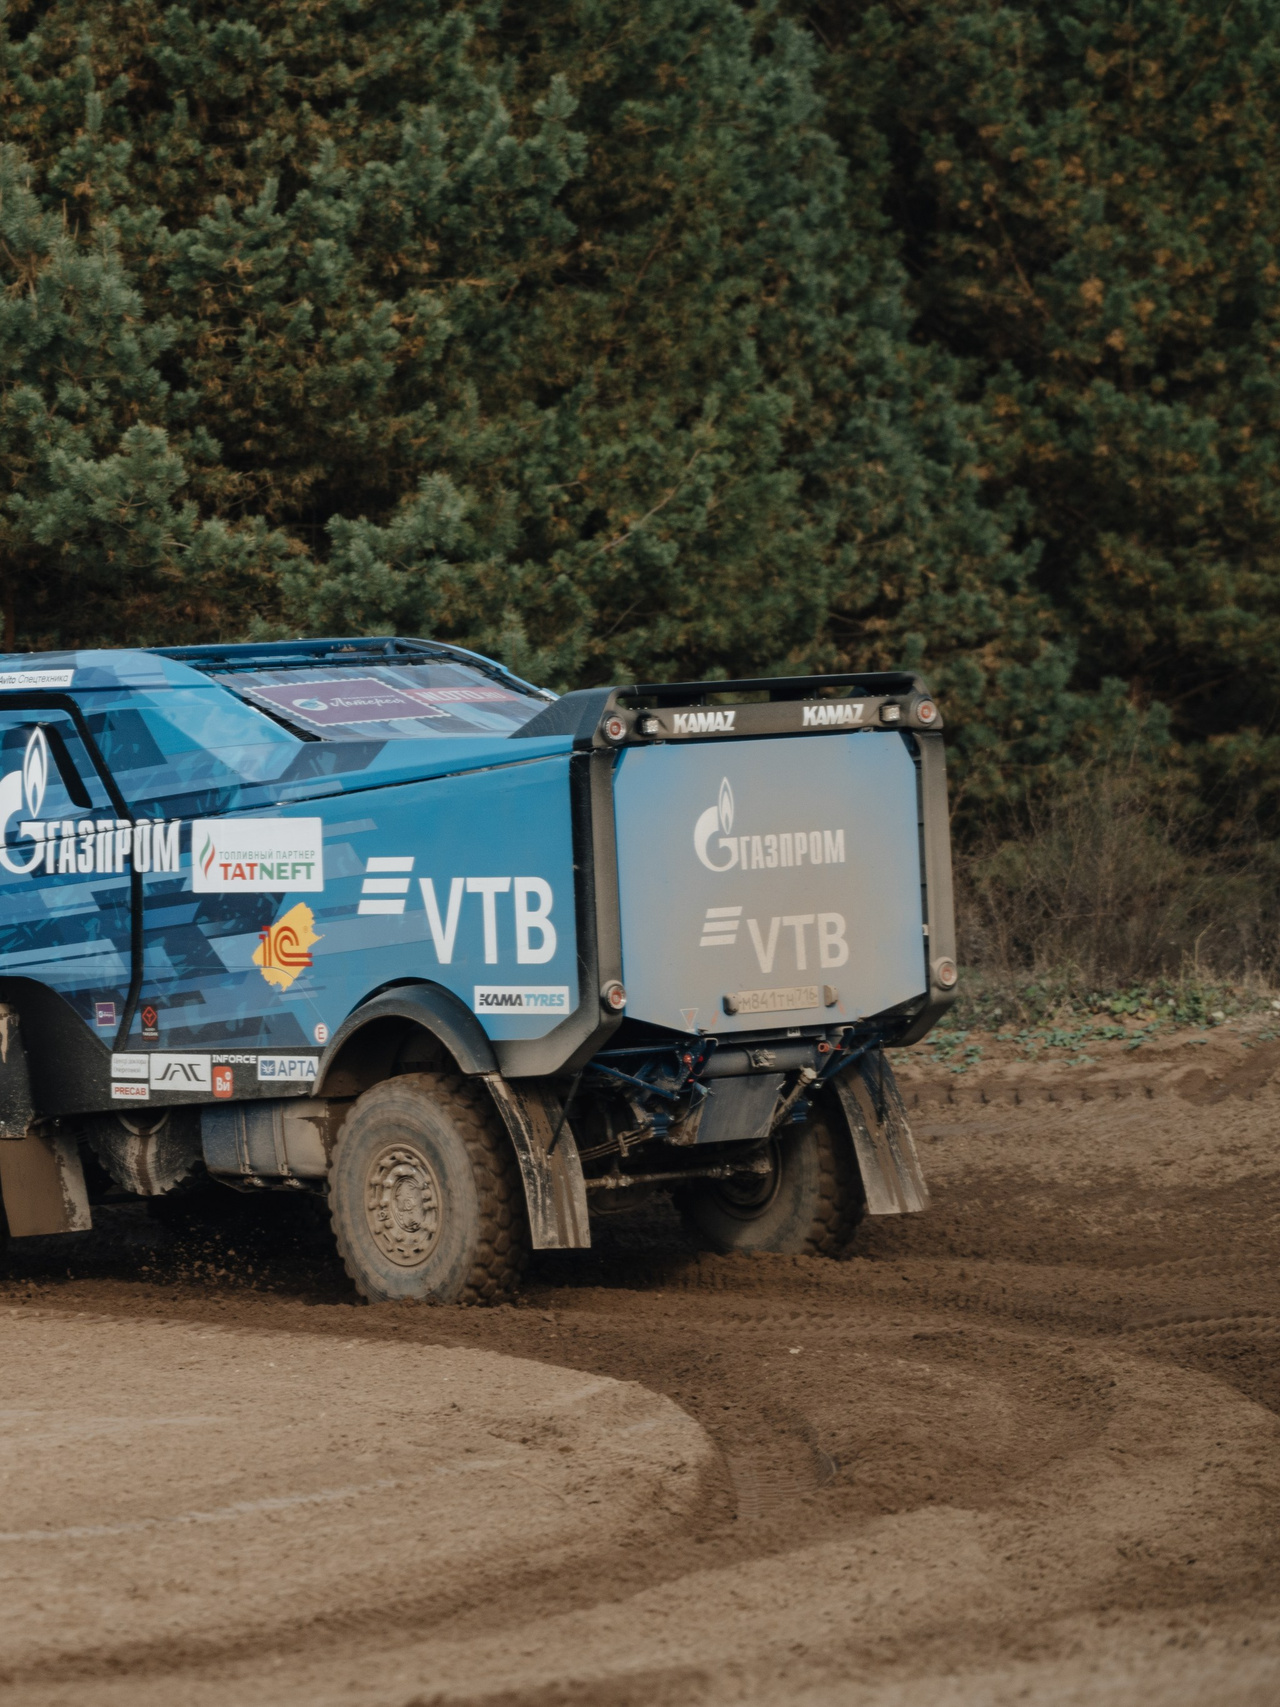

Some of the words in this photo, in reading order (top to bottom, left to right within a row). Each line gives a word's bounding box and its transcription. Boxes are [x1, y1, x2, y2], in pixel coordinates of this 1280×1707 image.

[18, 674, 68, 685] Спецтехника
[673, 711, 736, 733] KAMAZ
[802, 704, 864, 726] KAMAZ
[45, 818, 181, 874] ГАЗПРОМ
[219, 849, 274, 861] ТОПЛИВНЫЙ
[276, 850, 315, 860] ПАРТНЕР
[739, 829, 845, 870] ГАЗПРОМ
[219, 862, 316, 881] TATNEFT
[419, 876, 557, 964] VTB
[747, 912, 850, 973] VTB
[479, 993, 523, 1007] KAMA
[524, 993, 565, 1007] TYRES
[212, 1054, 257, 1064] INFORCE
[277, 1060, 318, 1077] АРТА
[114, 1086, 147, 1096] PRECAB
